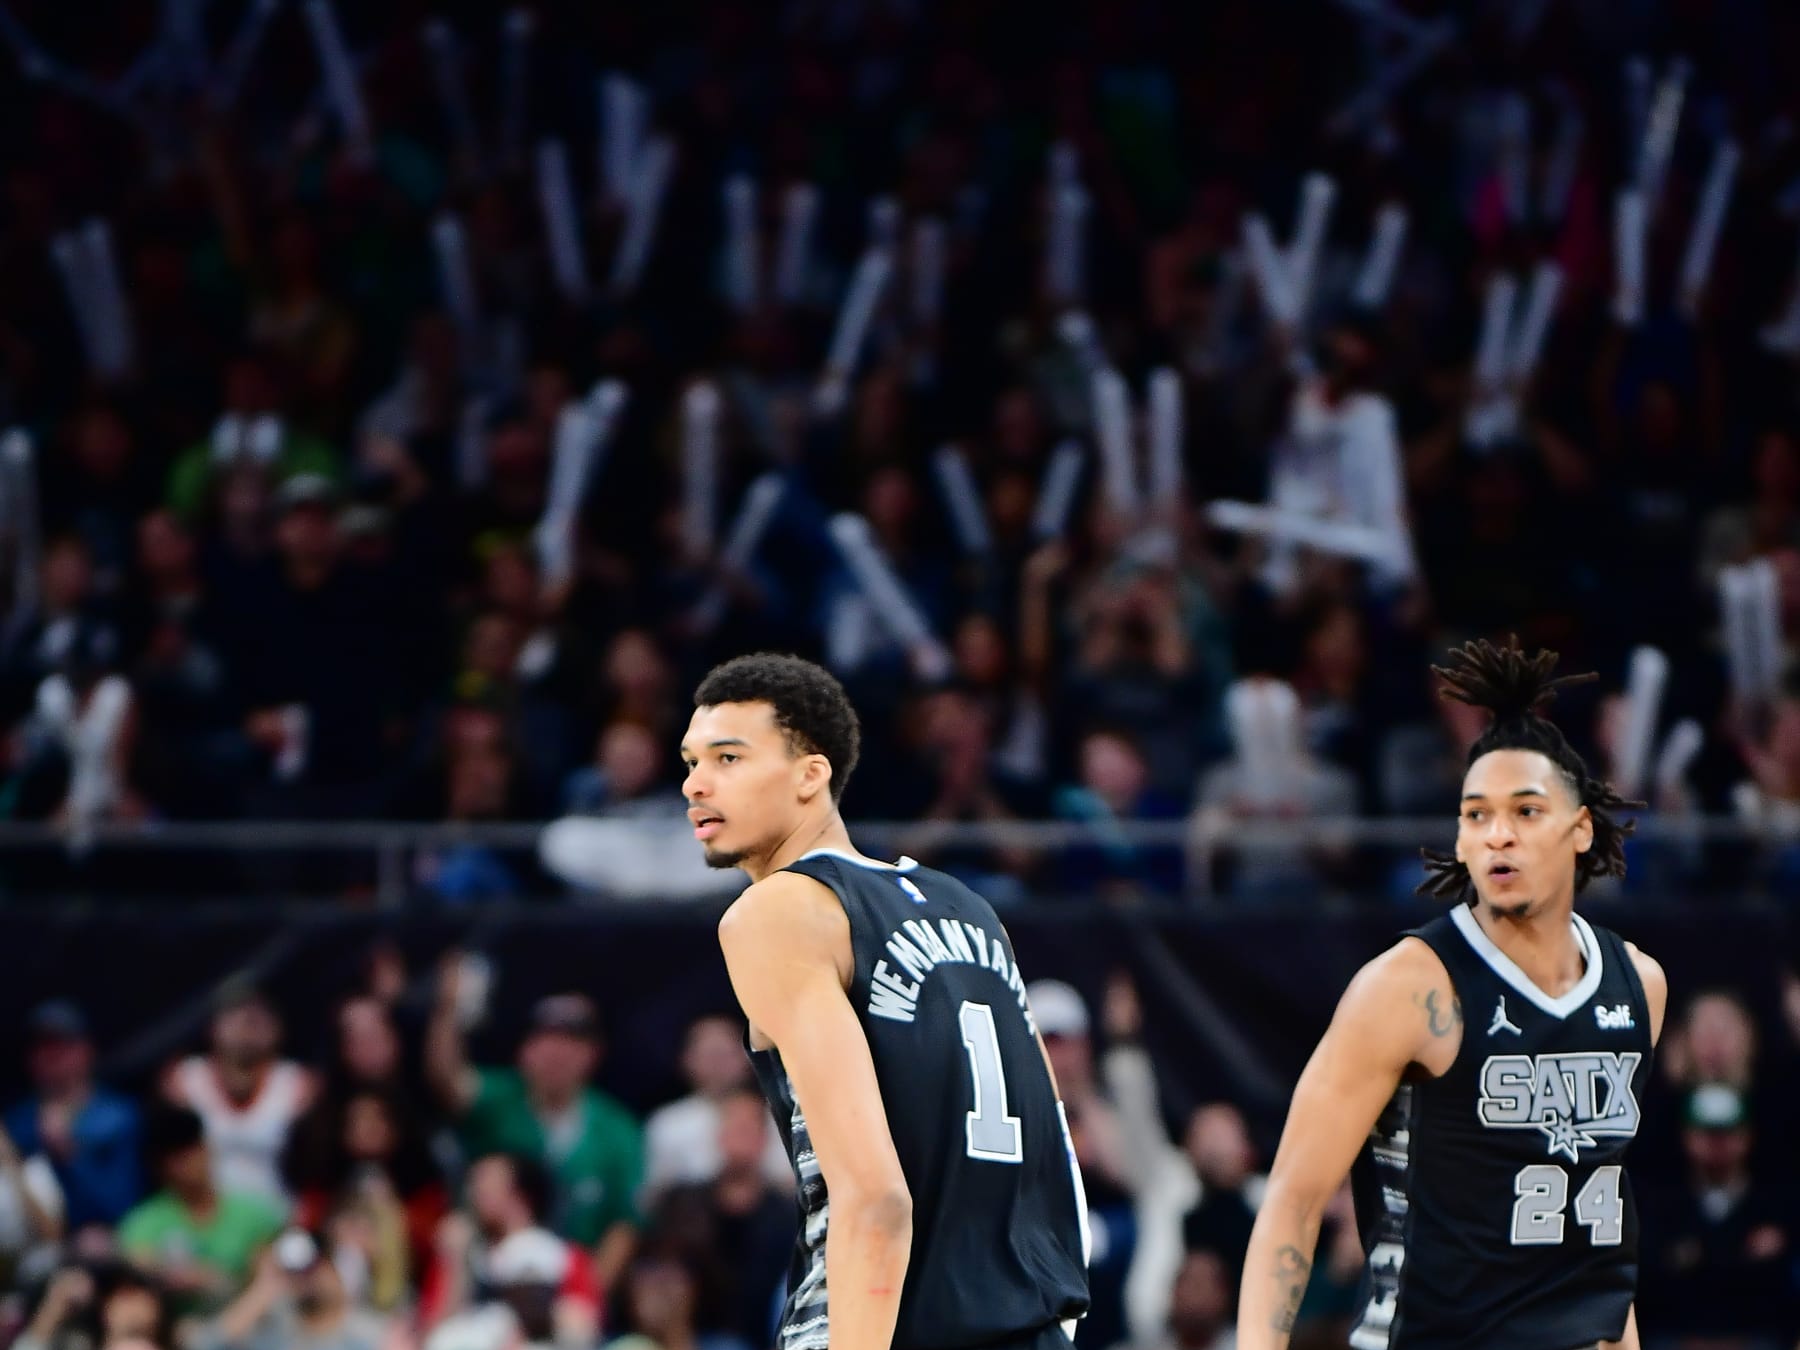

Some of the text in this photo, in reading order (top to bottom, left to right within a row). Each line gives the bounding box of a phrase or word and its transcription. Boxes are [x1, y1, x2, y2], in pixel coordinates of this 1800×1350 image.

[959, 1000, 1023, 1163] 1
[1478, 1052, 1642, 1137] SATX
[1511, 1165, 1623, 1245] 24
